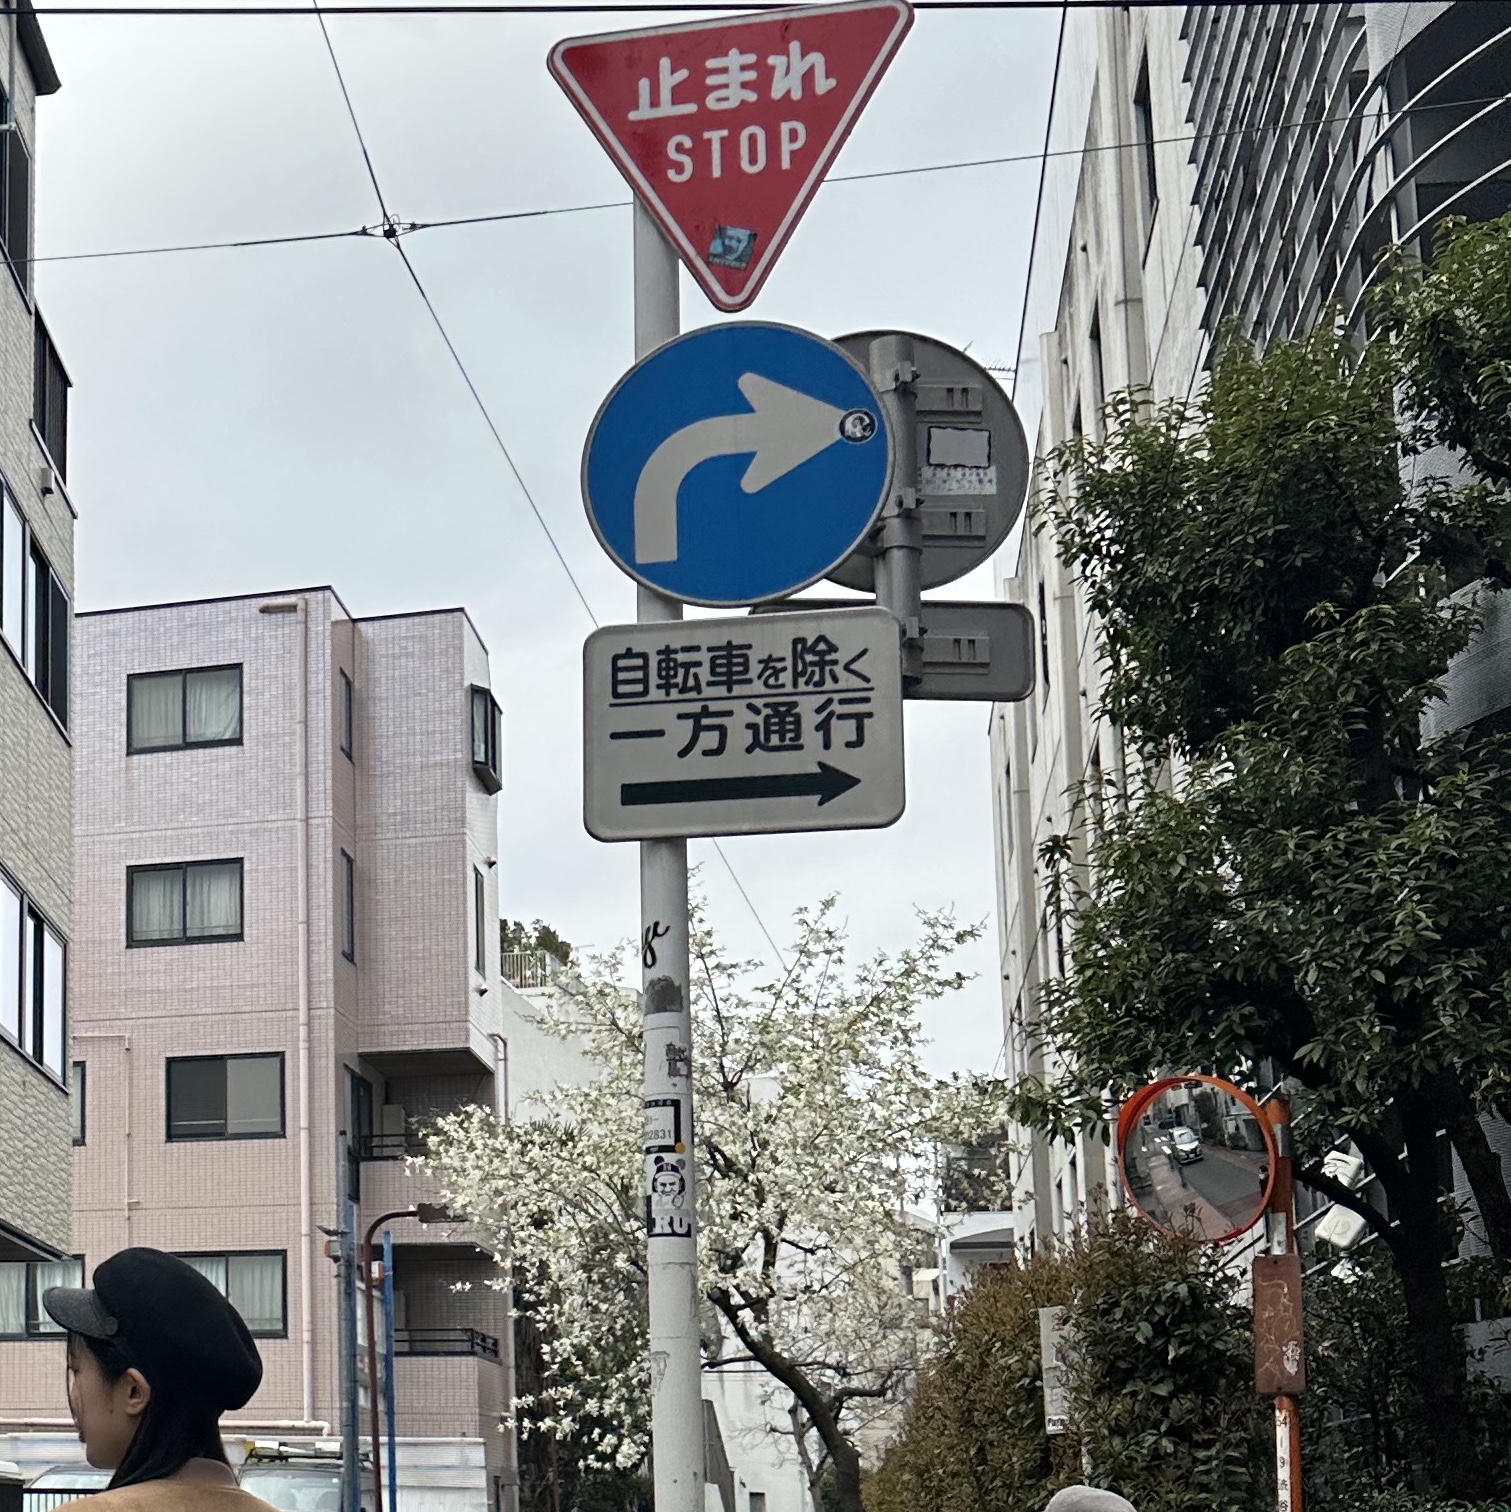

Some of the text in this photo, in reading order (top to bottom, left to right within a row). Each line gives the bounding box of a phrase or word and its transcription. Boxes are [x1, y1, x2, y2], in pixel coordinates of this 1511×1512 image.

[627, 40, 836, 122] 止まれ
[667, 121, 809, 183] STOP
[611, 636, 874, 699] 自転車を除く
[609, 694, 875, 756] 一方通行
